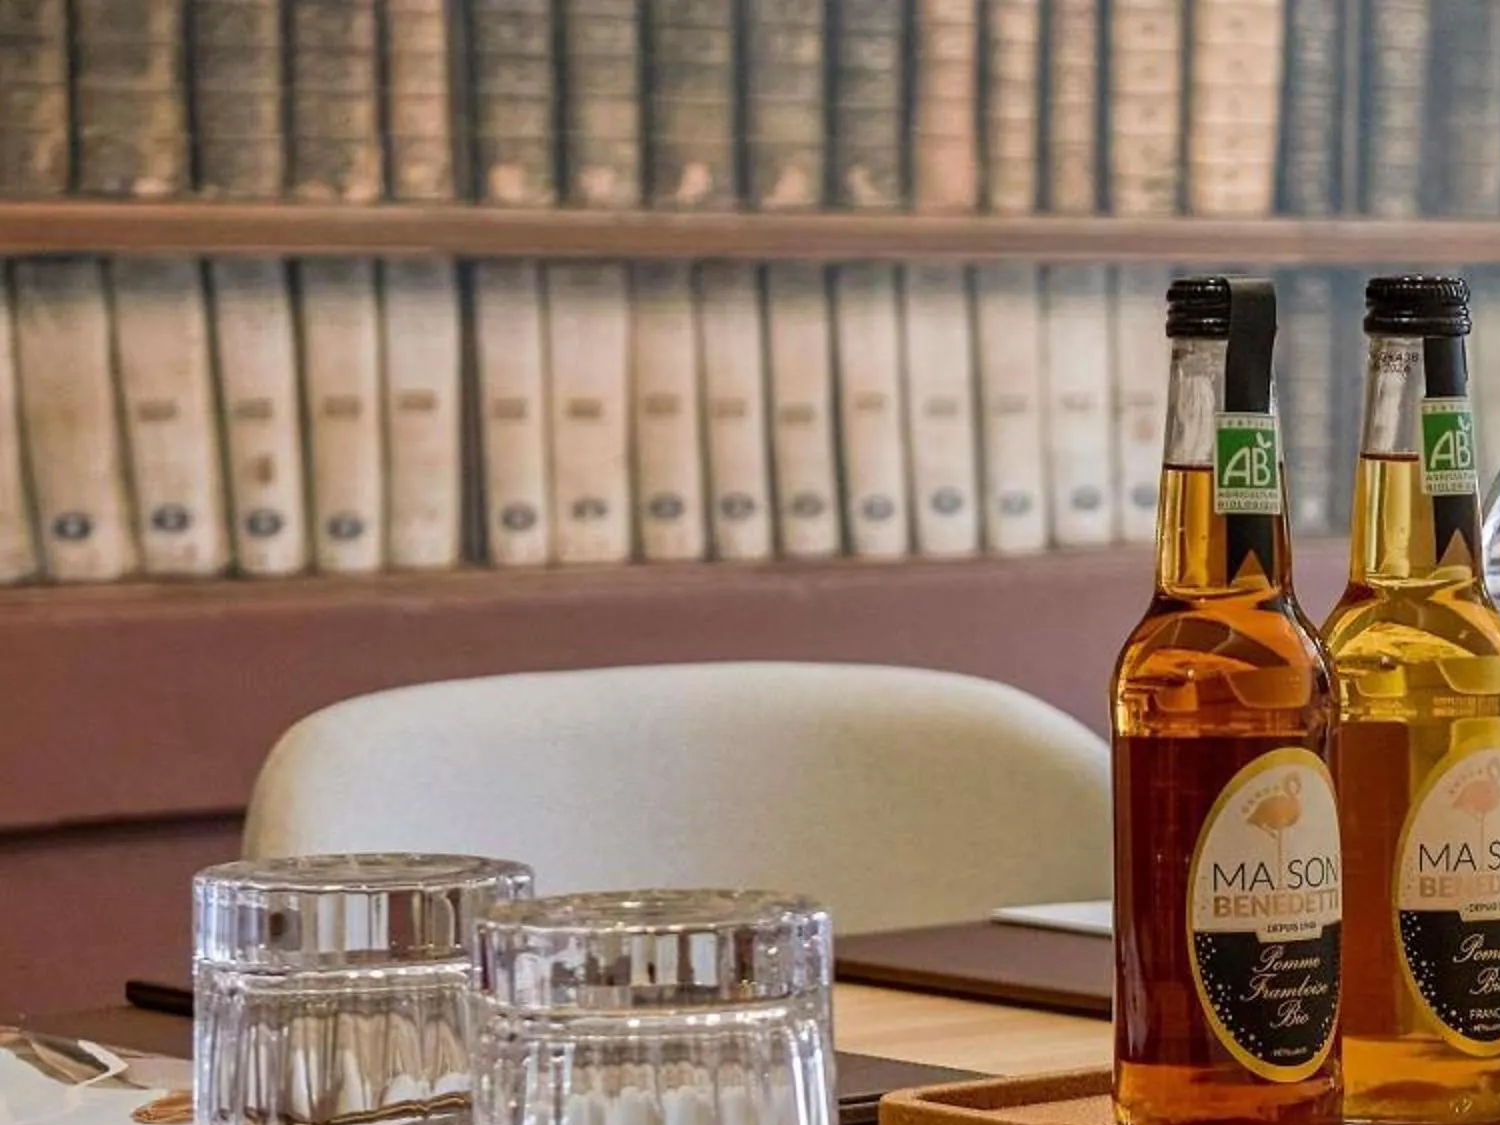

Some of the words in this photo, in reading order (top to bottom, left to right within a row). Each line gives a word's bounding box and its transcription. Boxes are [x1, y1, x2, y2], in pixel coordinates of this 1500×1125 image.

[1429, 429, 1472, 469] AB
[1222, 446, 1272, 487] AB
[1251, 945, 1321, 973] Pomme
[1239, 973, 1330, 1002] Framboise
[1268, 999, 1310, 1029] Bio
